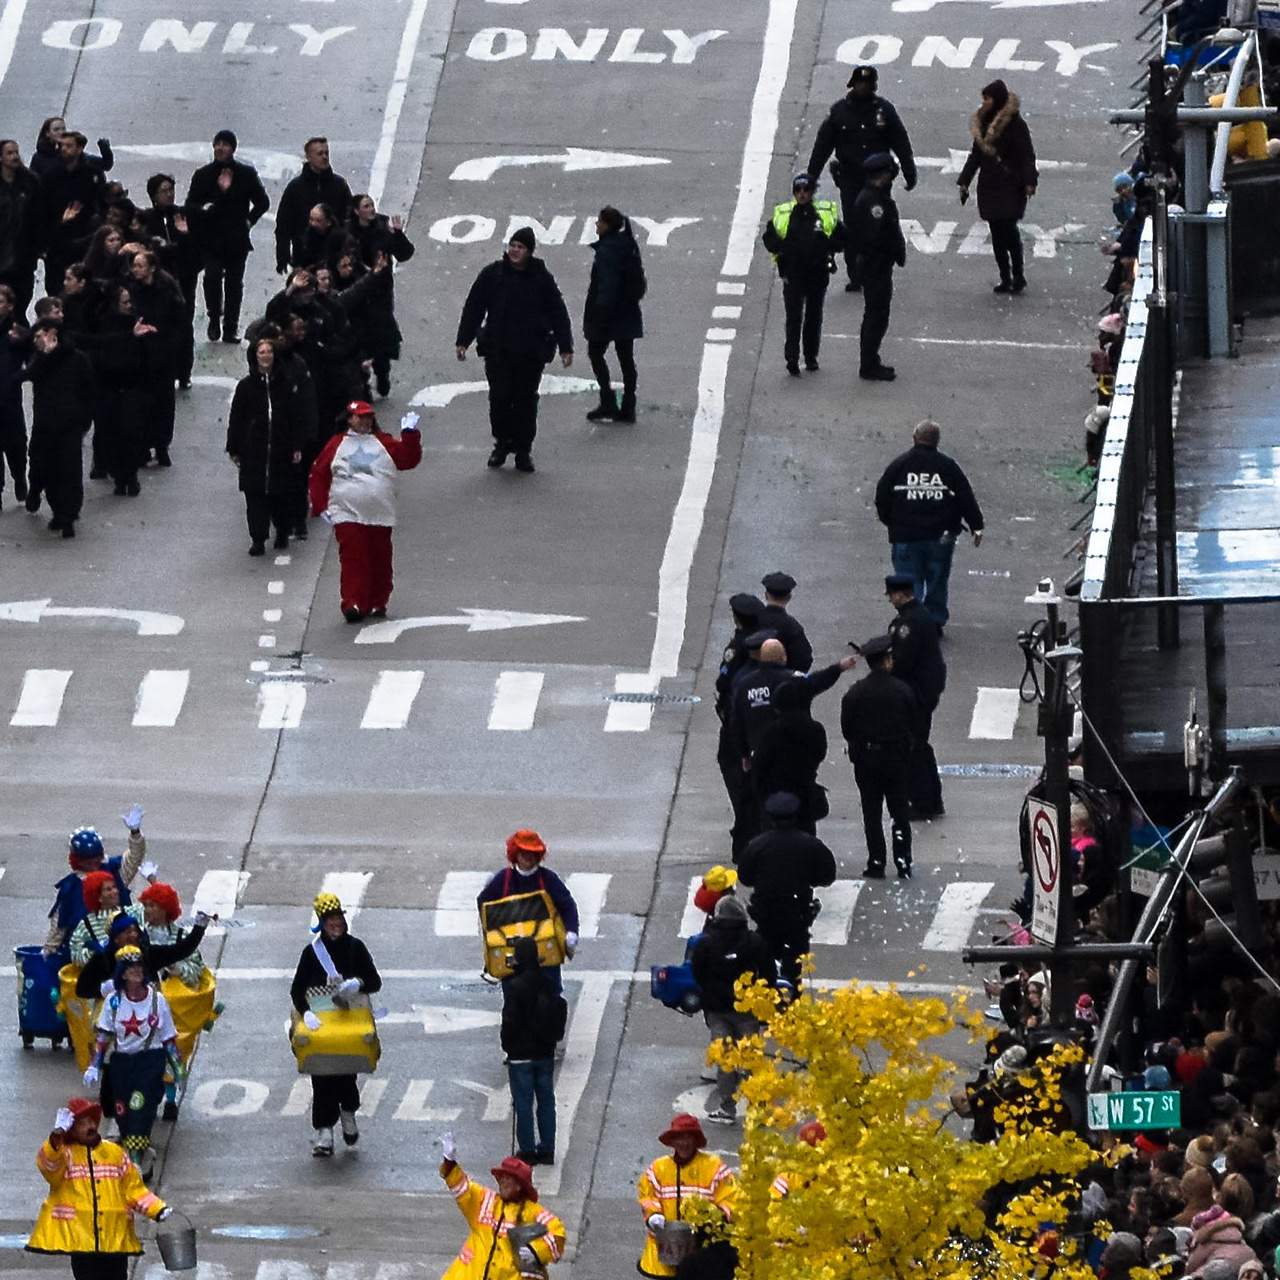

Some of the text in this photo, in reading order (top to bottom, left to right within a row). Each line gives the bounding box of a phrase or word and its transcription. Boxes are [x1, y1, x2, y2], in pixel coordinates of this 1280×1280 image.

[41, 16, 357, 57] ONLY
[465, 26, 729, 65] ONLY
[835, 33, 1118, 76] ONLY
[907, 472, 943, 486] DEA
[907, 490, 943, 500] NYPD
[1110, 1095, 1174, 1124] W 57 St
